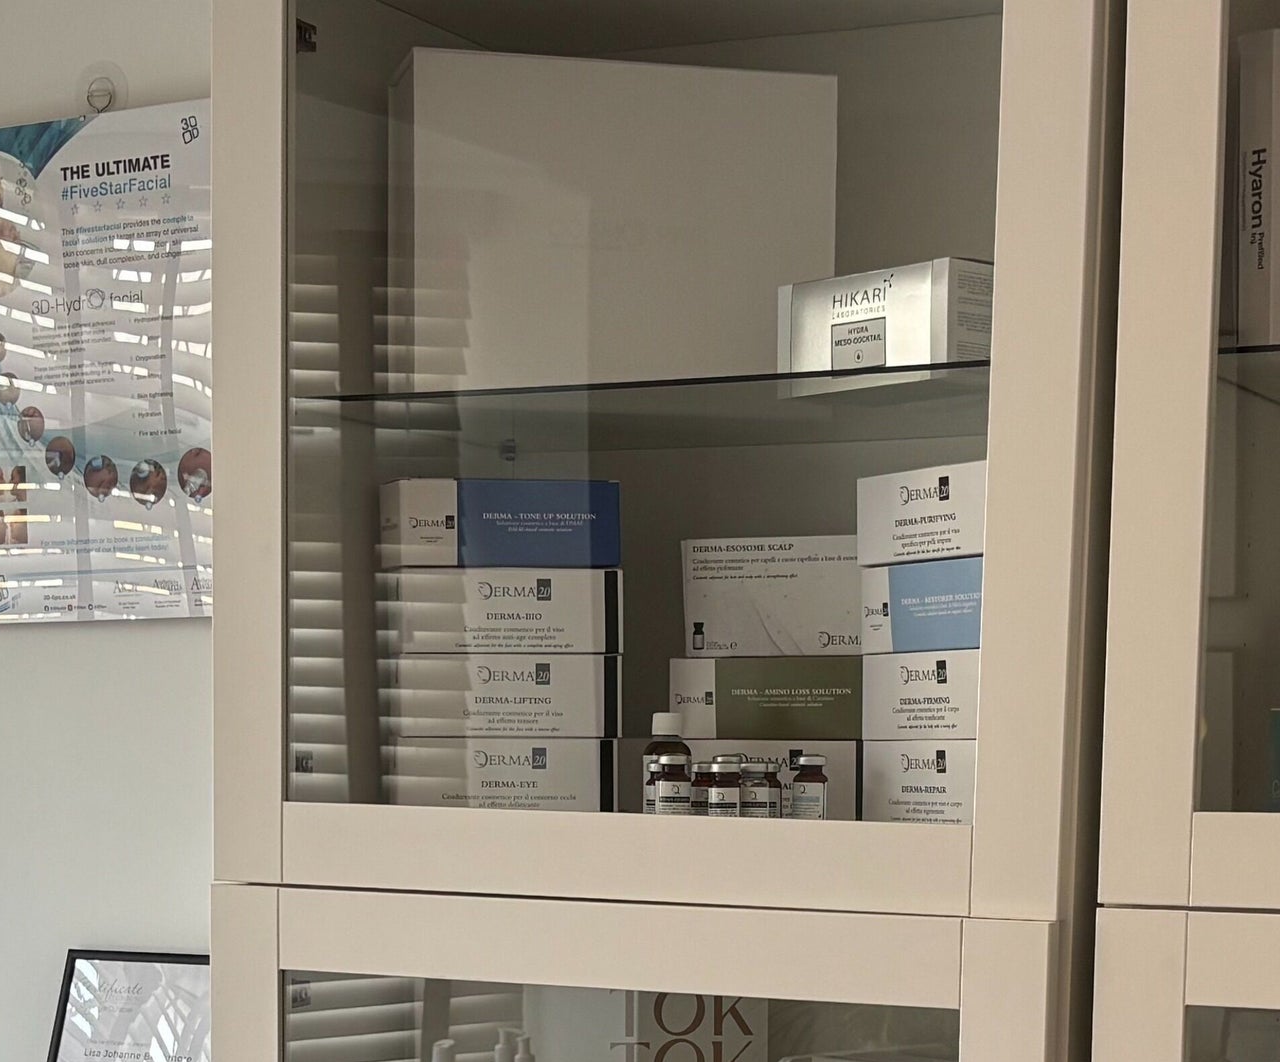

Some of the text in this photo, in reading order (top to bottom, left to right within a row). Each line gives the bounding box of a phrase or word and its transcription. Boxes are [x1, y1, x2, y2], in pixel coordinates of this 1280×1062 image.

[60, 153, 171, 182] THE ULTIMATE
[61, 173, 171, 201] #FiveStarFacial
[1248, 148, 1267, 232] Hyaron
[832, 286, 887, 310] HIKARI
[832, 304, 886, 320] LABORATORIES
[847, 325, 869, 336] HYDRA
[899, 485, 939, 506] DERMA
[408, 516, 445, 529] DERMA
[482, 512, 597, 521] DERMA TONE UP SOLUTION
[767, 542, 794, 552] SCALP
[477, 581, 536, 600] DERMA
[818, 631, 862, 649] DERM
[476, 665, 535, 685] DERMA
[899, 665, 936, 685] DERMA
[474, 696, 552, 705] DERMA-LIFTING
[731, 687, 852, 696] DERMA AMINO LOSS SOLUTION
[473, 750, 531, 769] DERMA
[900, 752, 936, 774] DERMA
[481, 780, 538, 789] DERMA-EYE
[901, 785, 948, 795] DERMA-REPAIR
[609, 988, 754, 1038] TOK
[83, 1048, 102, 1058] Lisa
